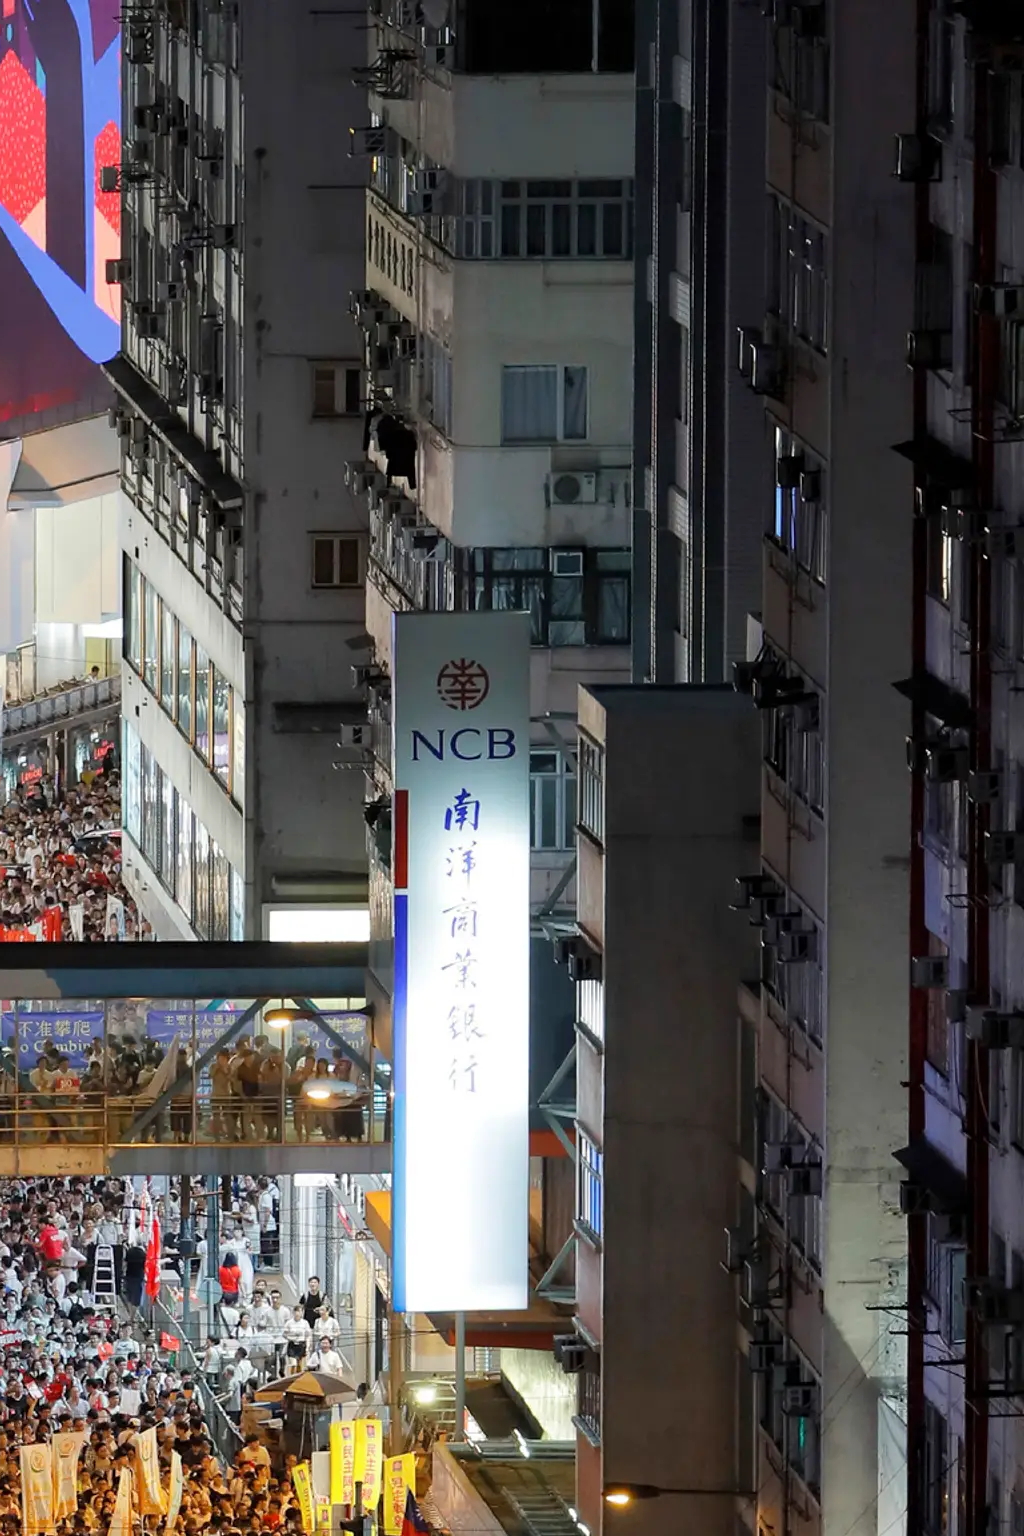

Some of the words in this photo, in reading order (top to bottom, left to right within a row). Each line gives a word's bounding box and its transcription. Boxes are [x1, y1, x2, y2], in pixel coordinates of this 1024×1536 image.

[410, 728, 517, 762] NCB
[441, 789, 488, 1094] 南洋商業銀行
[19, 1020, 91, 1038] 不准攀爬
